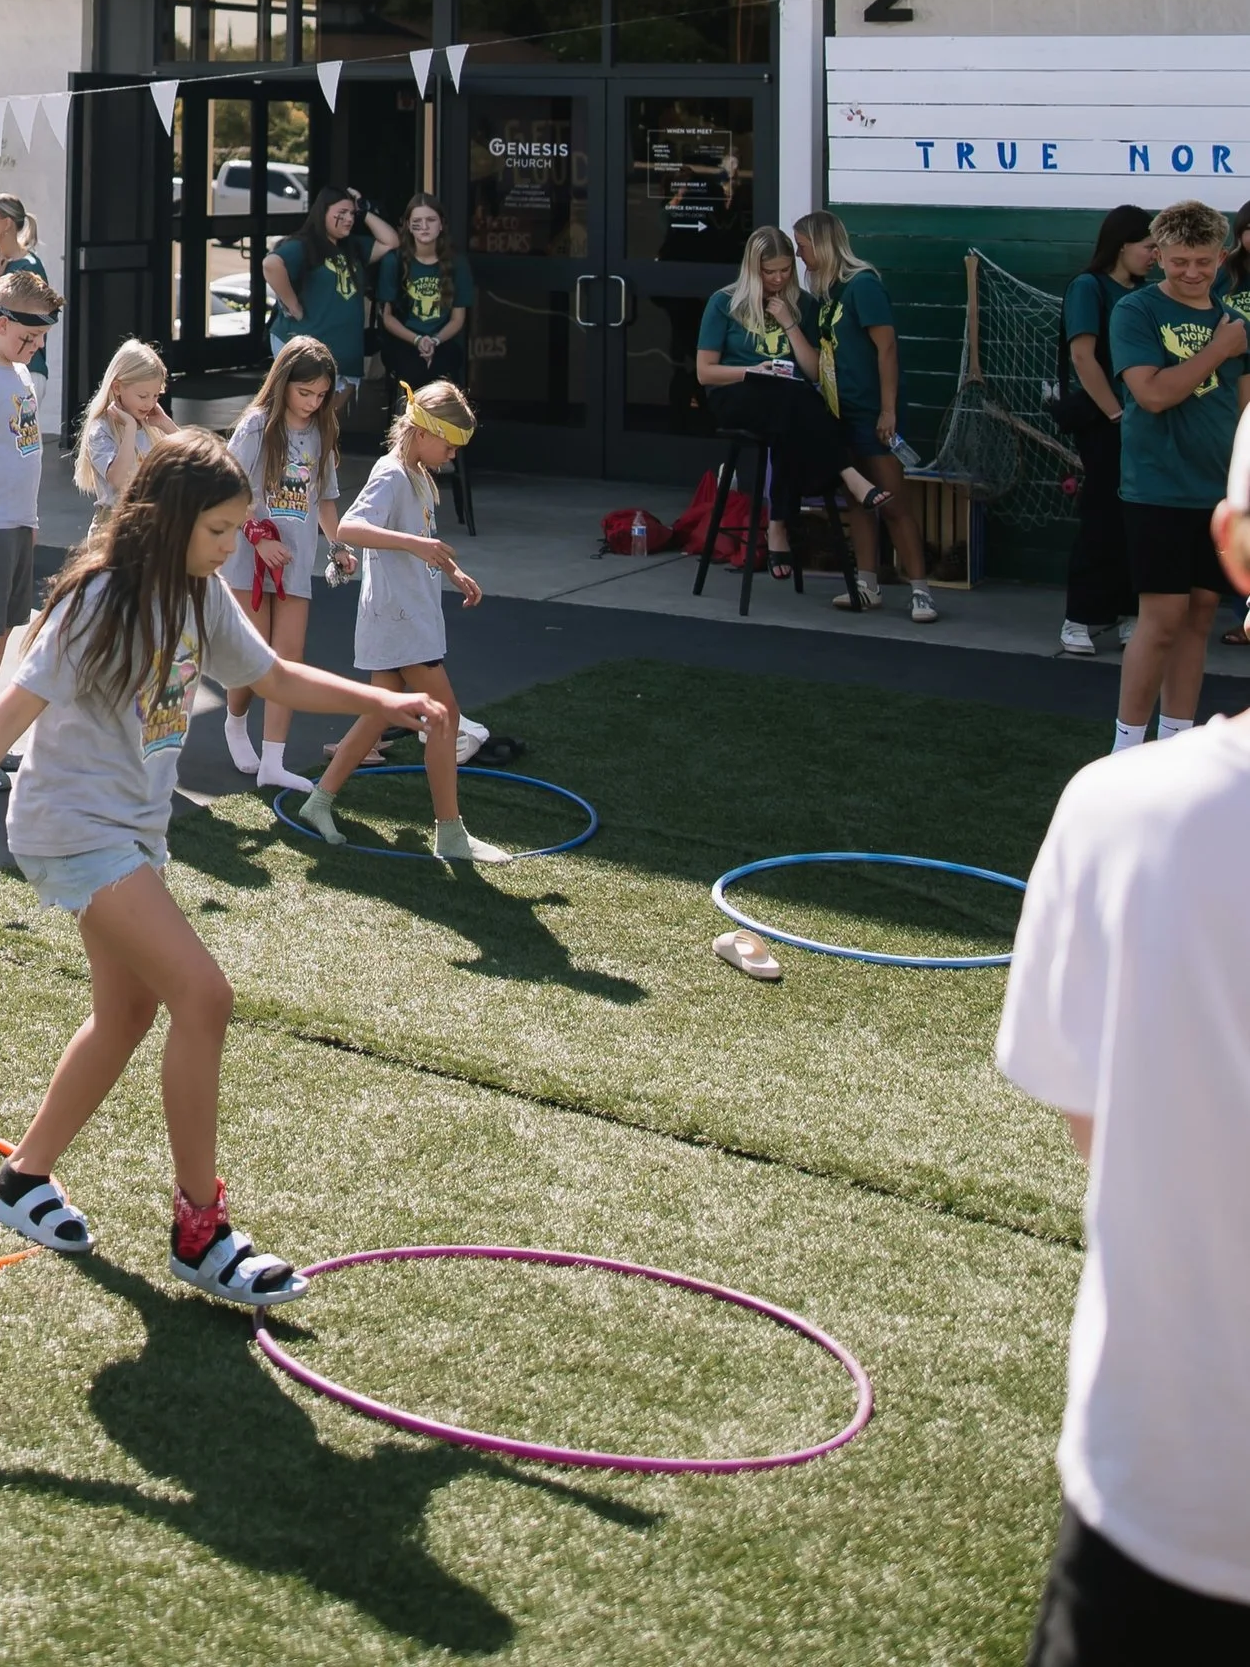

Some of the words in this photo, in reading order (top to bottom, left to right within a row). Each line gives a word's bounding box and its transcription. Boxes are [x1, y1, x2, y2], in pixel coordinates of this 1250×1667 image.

[489, 137, 568, 157] GENESIS
[915, 141, 1059, 170] TRUE
[505, 157, 552, 169] CHURCH
[1181, 323, 1213, 335] TRUE
[1180, 333, 1212, 344] NORT
